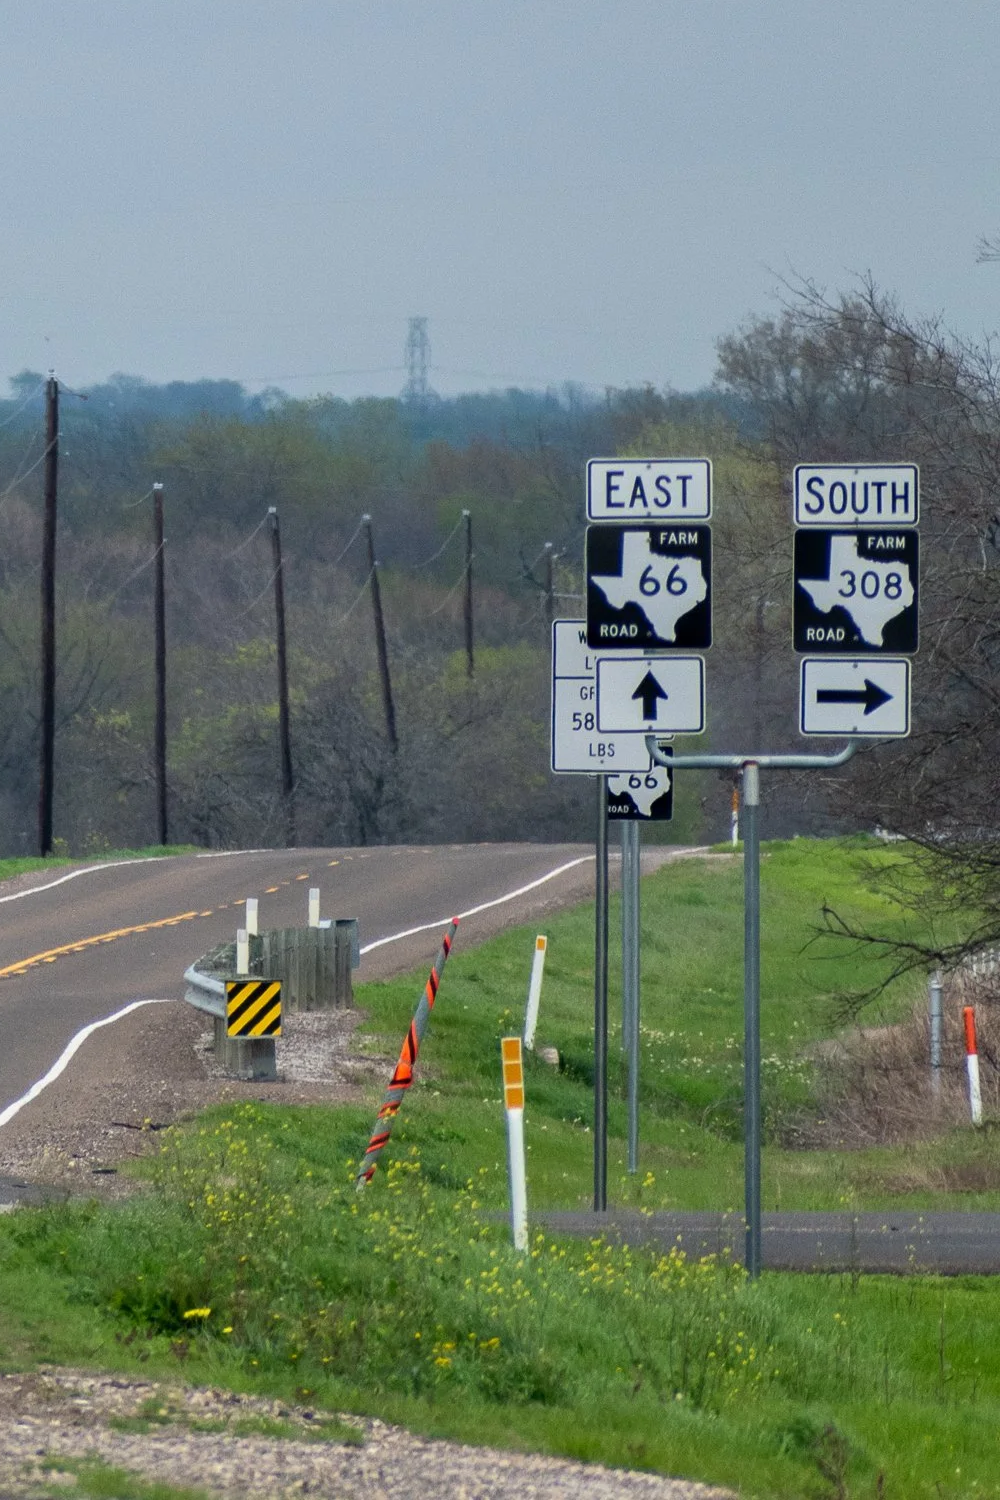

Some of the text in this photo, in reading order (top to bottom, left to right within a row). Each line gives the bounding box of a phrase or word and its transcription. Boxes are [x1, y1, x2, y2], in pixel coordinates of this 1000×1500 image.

[605, 471, 693, 509] EAST
[804, 476, 910, 515] SOUTH
[659, 532, 698, 545] FARM
[867, 537, 906, 550] FARM
[638, 564, 688, 597] 66
[838, 571, 903, 600] 308
[600, 624, 639, 638] ROAD
[806, 628, 845, 642] ROAD
[589, 743, 616, 758] LBS
[628, 774, 659, 790] 66
